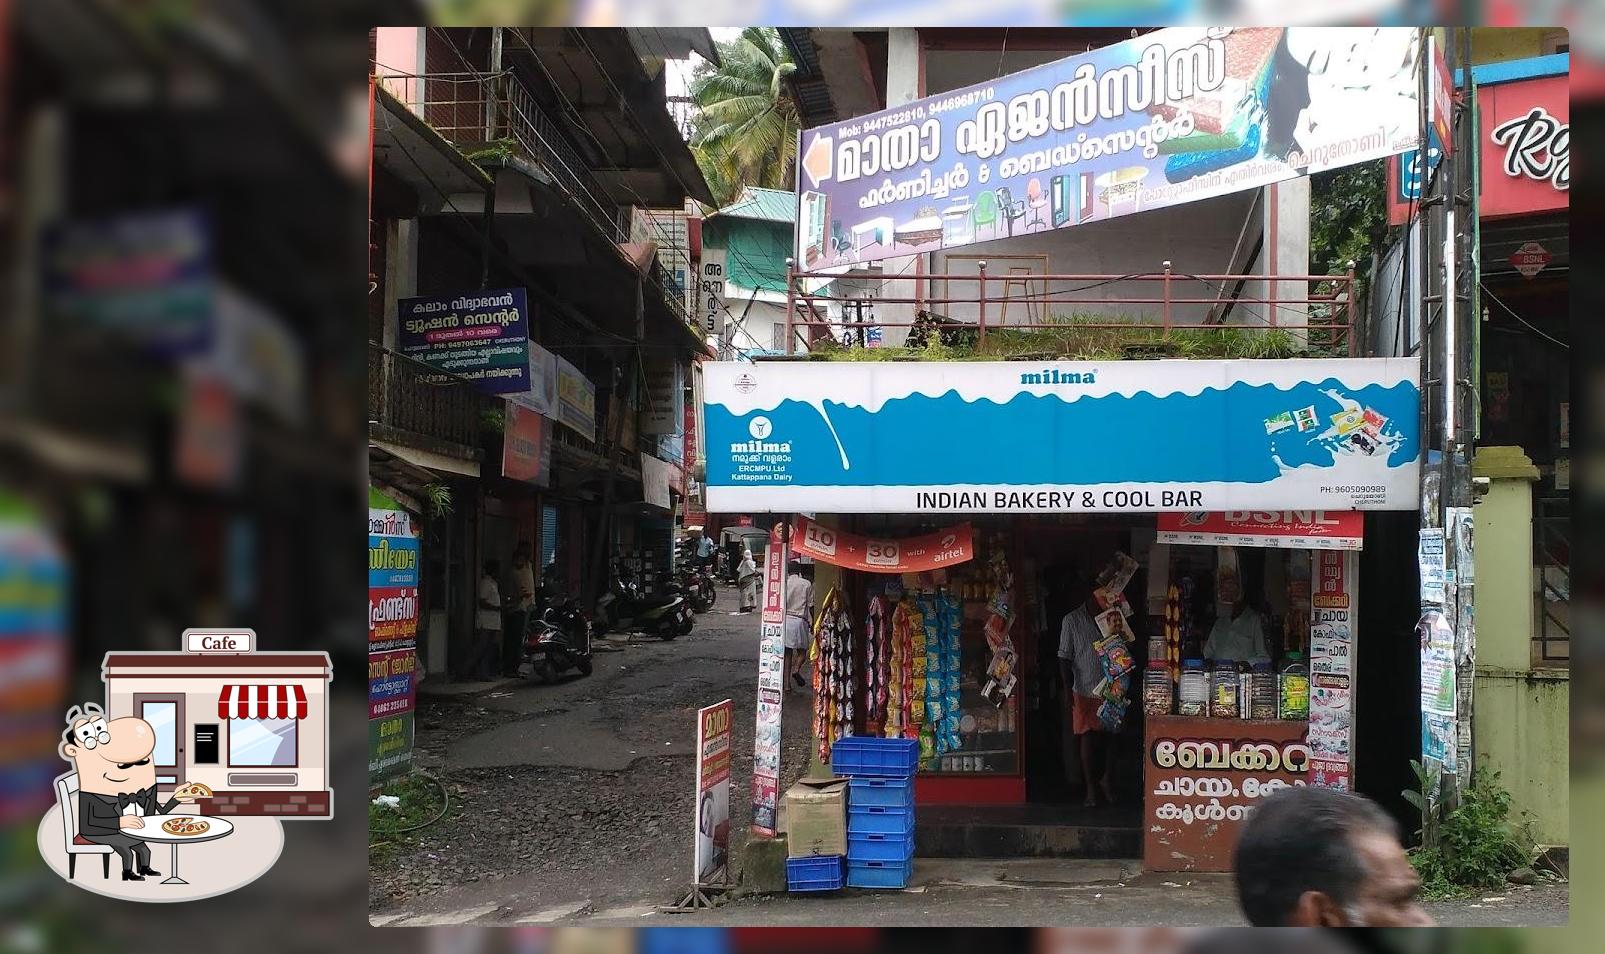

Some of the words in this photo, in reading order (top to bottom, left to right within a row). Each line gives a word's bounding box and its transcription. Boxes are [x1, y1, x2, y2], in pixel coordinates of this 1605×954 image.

[839, 126, 861, 139] Mob:
[837, 118, 942, 183] മാതാ
[413, 301, 447, 314] കലാം
[731, 474, 772, 482] Kattappana
[773, 474, 793, 482] Dairy
[1335, 485, 1386, 493] 9605090989
[917, 491, 987, 508] INDIAN
[994, 491, 1075, 508] BAKERY
[1082, 491, 1096, 507] &
[1103, 491, 1154, 507] COOL
[1162, 490, 1202, 507] BAR
[808, 527, 834, 547] 10
[868, 545, 897, 558] 30
[907, 548, 926, 557] with
[933, 546, 964, 563] airtel
[1321, 611, 1348, 622] ചായ
